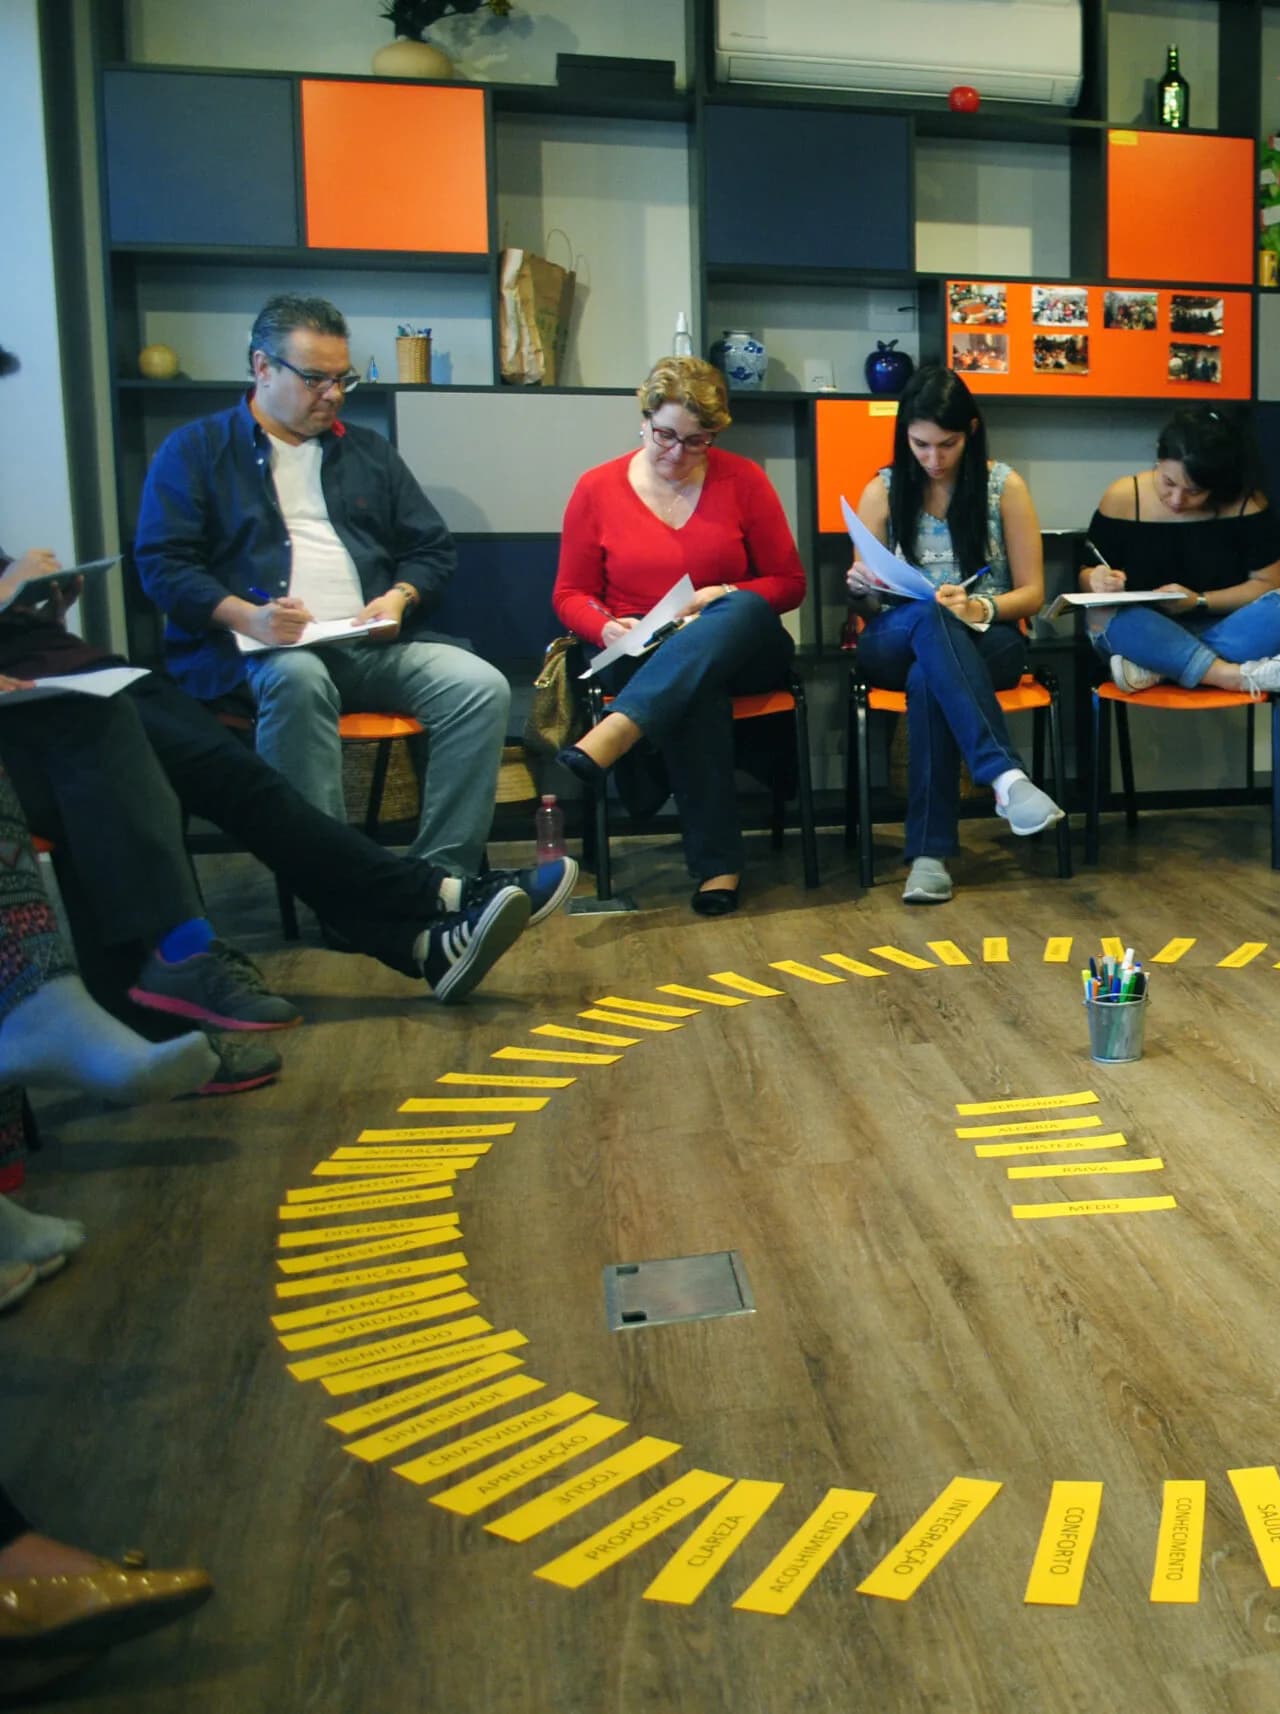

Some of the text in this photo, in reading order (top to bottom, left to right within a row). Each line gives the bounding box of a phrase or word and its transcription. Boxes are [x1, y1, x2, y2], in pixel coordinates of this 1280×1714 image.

[998, 1123, 1058, 1133] ALEGRIA
[1017, 1142, 1085, 1151] TRISTEZA
[307, 1194, 423, 1213] INTEGRIDADE
[324, 1177, 419, 1193] AVENTURA
[1068, 1204, 1119, 1212] MEDO
[324, 1220, 415, 1238] DIVERSÃO
[324, 1239, 417, 1262] PRESENÇA
[331, 1265, 412, 1284] AFEIÇÃO
[324, 1289, 415, 1316] ATENÇÃO
[335, 1309, 421, 1334] VERDADE
[324, 1329, 453, 1368] SIGNIFICADO
[363, 1366, 487, 1418] TRANQUILIDADE
[383, 1391, 504, 1443] DIVERSIDADE
[426, 1408, 558, 1468] CRIATIVIDADE
[477, 1434, 588, 1495] APRECIAÇÃO
[558, 1470, 622, 1505] TOQUE
[584, 1496, 687, 1561] PROPÓSITO
[687, 1515, 745, 1568] CLAREZA
[893, 1498, 972, 1576] INTEGRAÇÃO
[1049, 1506, 1085, 1576] CONFORTO
[1165, 1496, 1193, 1582] CONHECIMENTO
[770, 1509, 849, 1594] ACOLHIMENTO
